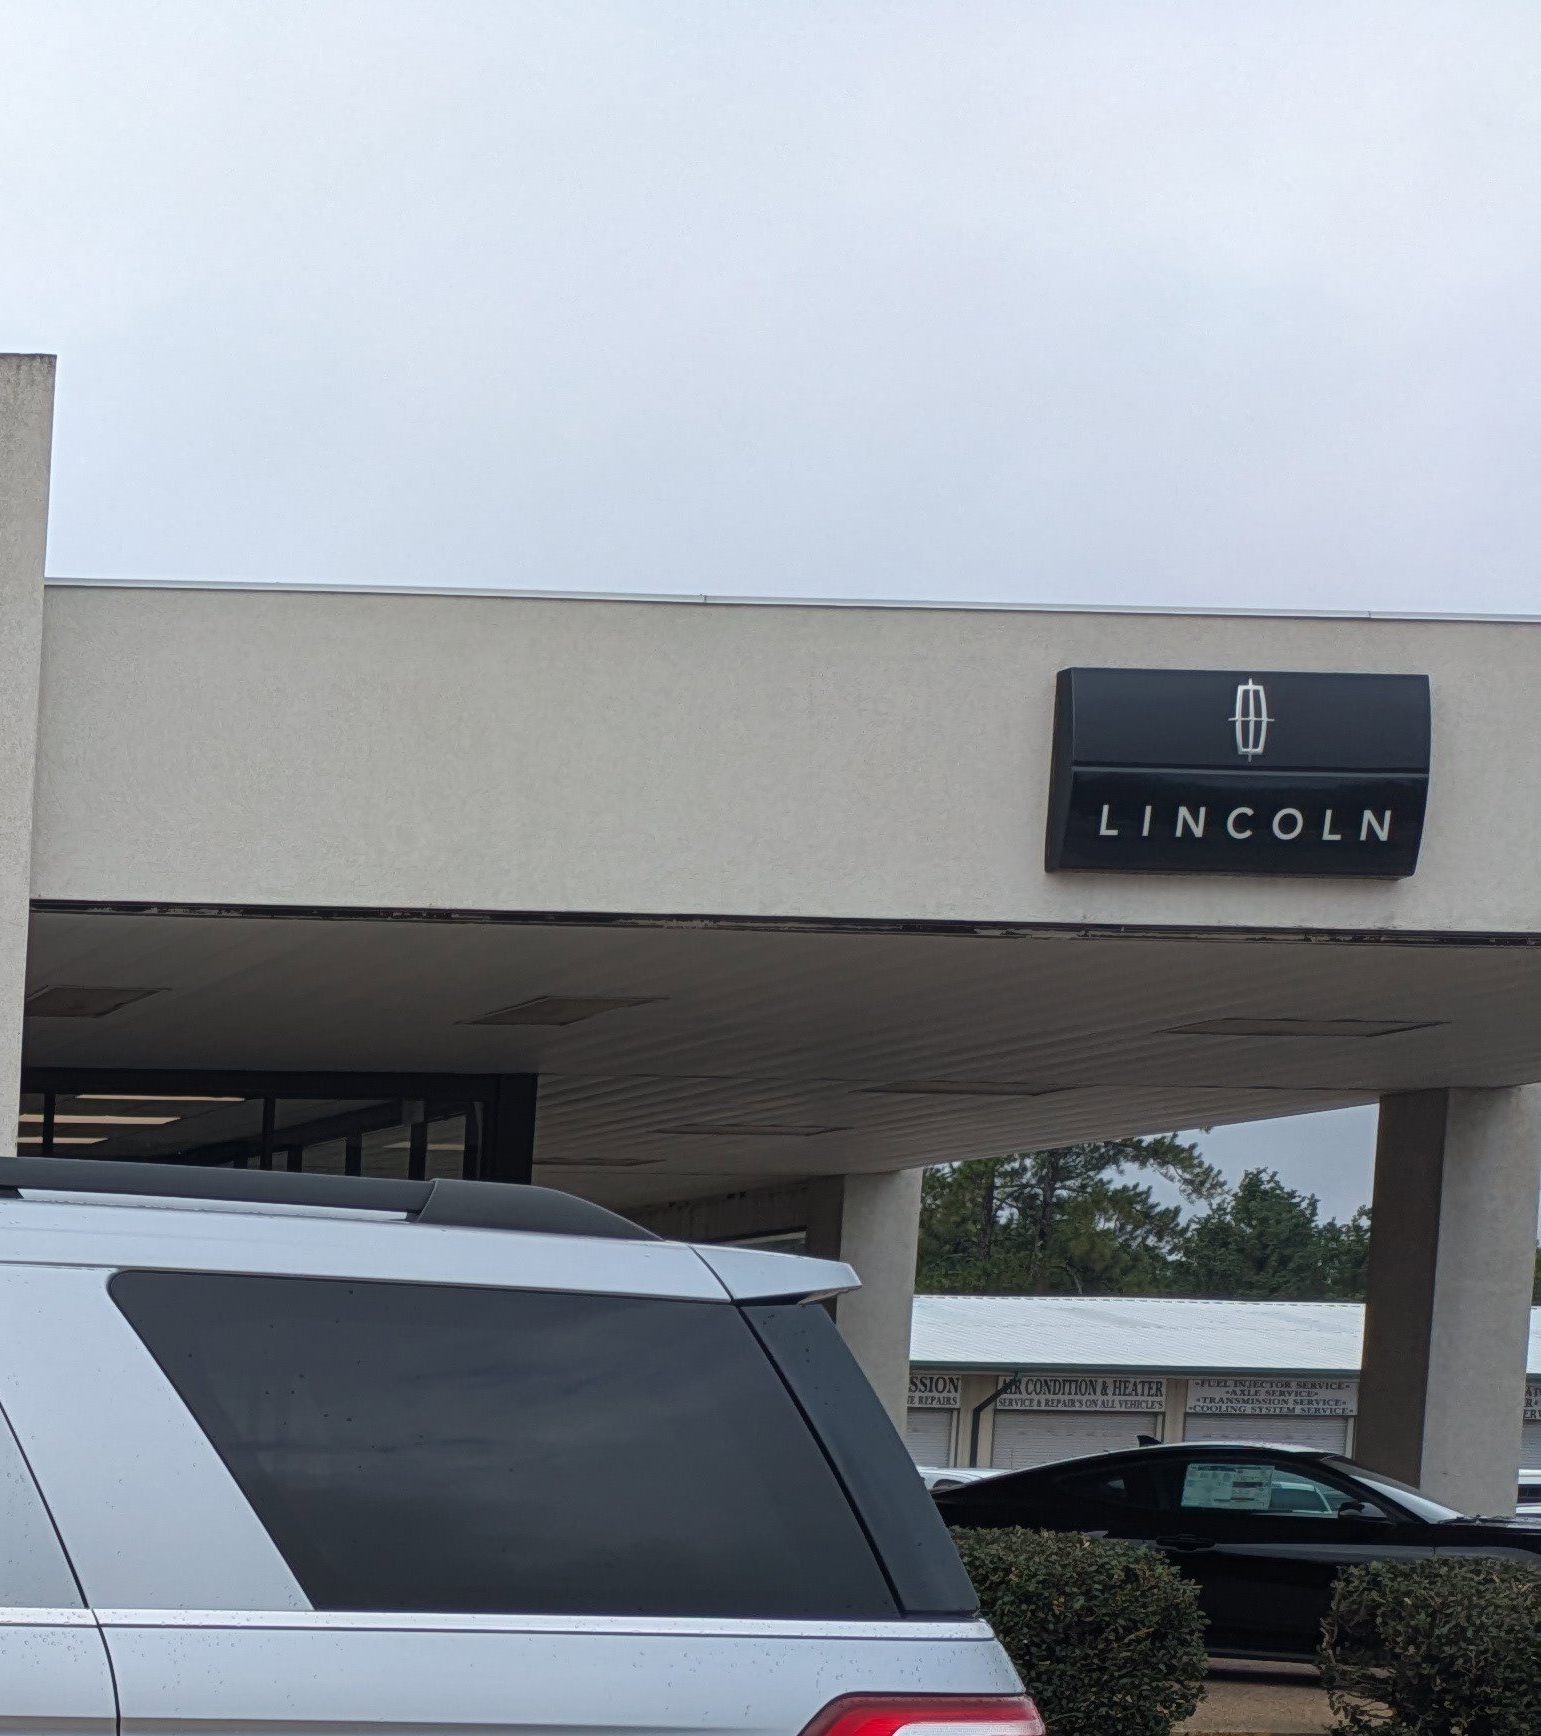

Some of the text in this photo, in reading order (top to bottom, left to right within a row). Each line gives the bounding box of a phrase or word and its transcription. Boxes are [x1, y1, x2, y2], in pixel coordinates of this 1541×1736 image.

[1099, 804, 1392, 842] LINCOLN
[1024, 1378, 1097, 1396] CONDITION
[1100, 1380, 1110, 1397] &
[1112, 1379, 1163, 1398] HEATER
[1233, 1380, 1293, 1389] INJECTOR
[1296, 1381, 1345, 1390] SERVICE
[1265, 1389, 1315, 1397] SERVICE
[918, 1396, 957, 1406] REPAIRS
[998, 1397, 1034, 1408] SERVICE
[1036, 1398, 1042, 1408] &
[1085, 1400, 1098, 1409] ON
[1100, 1400, 1116, 1410] ALL
[1292, 1398, 1342, 1407] SERVICE
[1192, 1405, 1349, 1415] COOLING SYSTEM SERVICE
